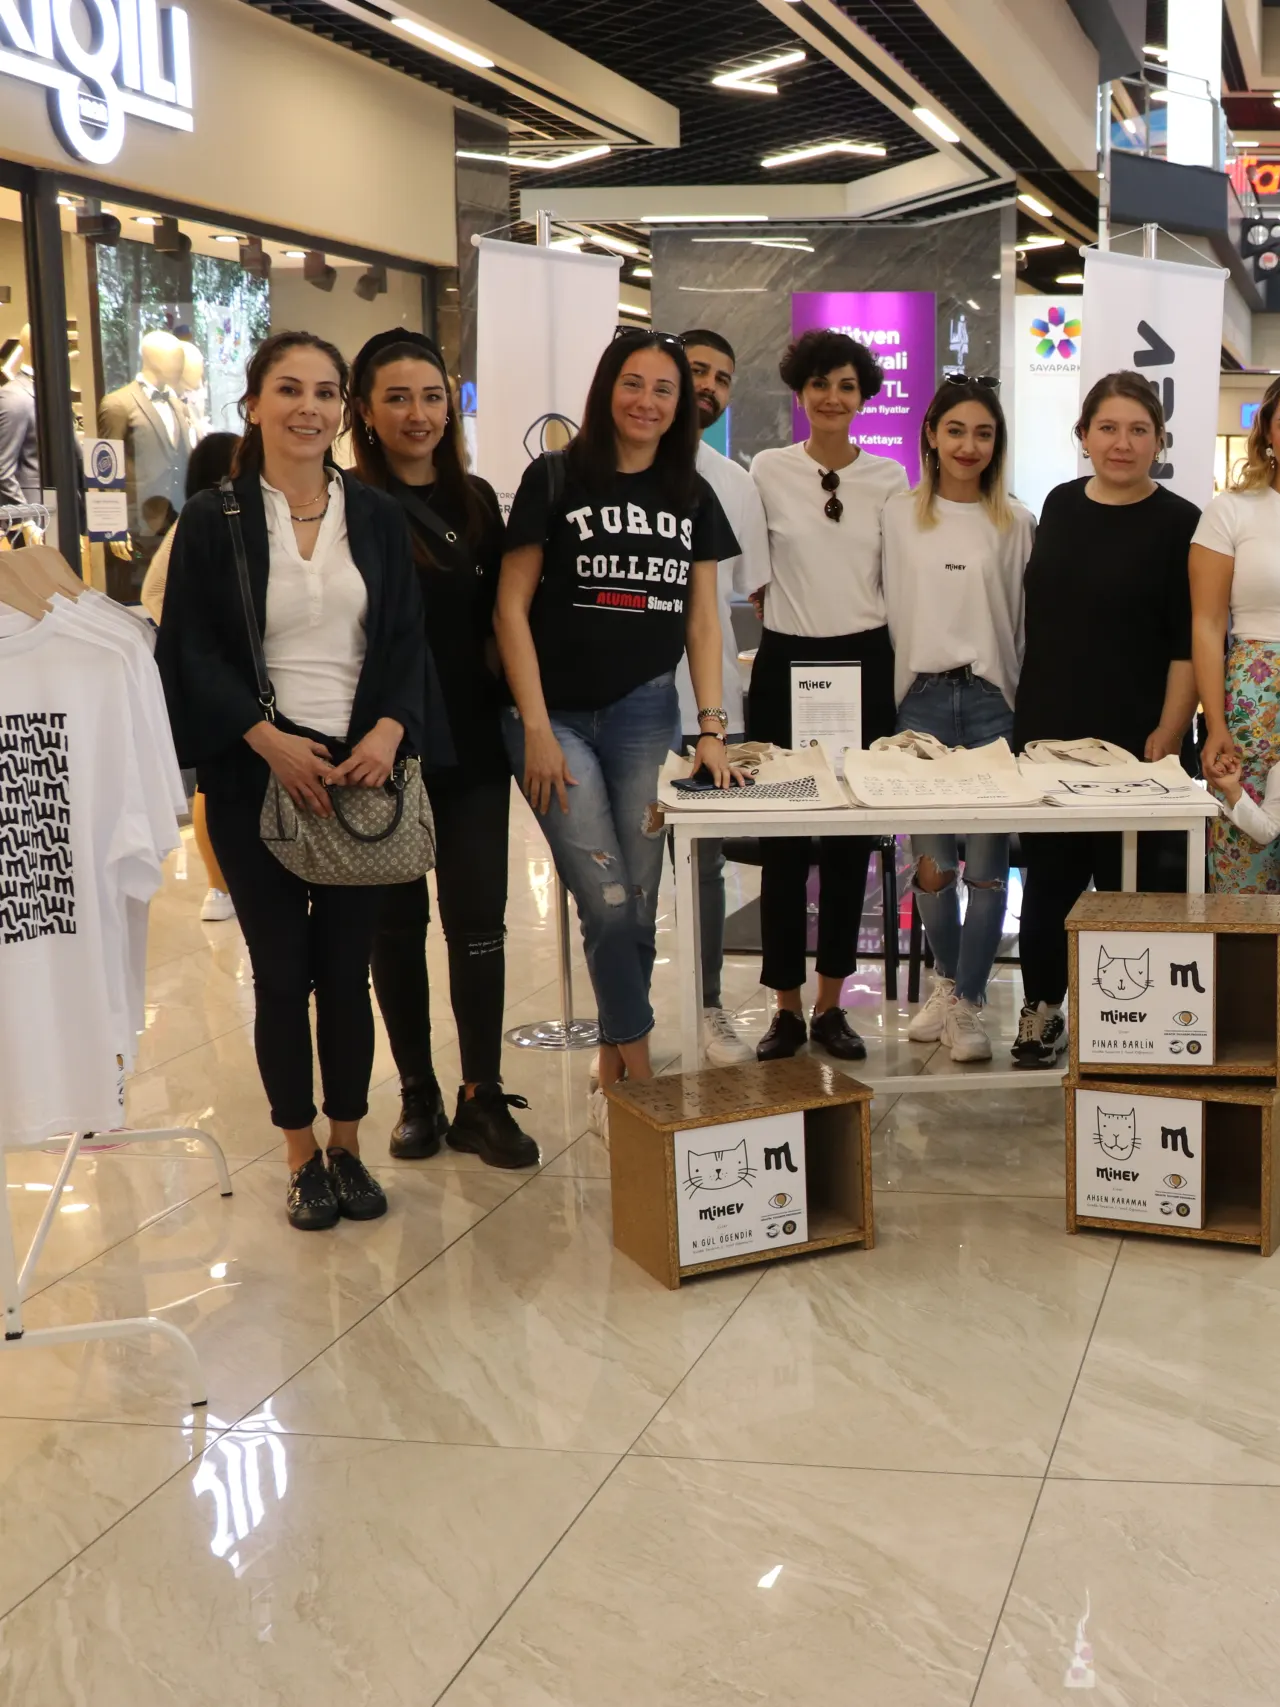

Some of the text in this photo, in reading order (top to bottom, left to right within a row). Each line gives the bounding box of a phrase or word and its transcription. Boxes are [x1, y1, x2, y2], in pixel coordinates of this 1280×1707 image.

[878, 405, 910, 415] fiyatlar
[859, 434, 903, 447] Kattayız
[566, 502, 693, 551] TOROS
[576, 554, 690, 586] COLLEGE
[1092, 1040, 1118, 1048] PINAR
[1086, 1194, 1147, 1207] AHSEN KARAMAN
